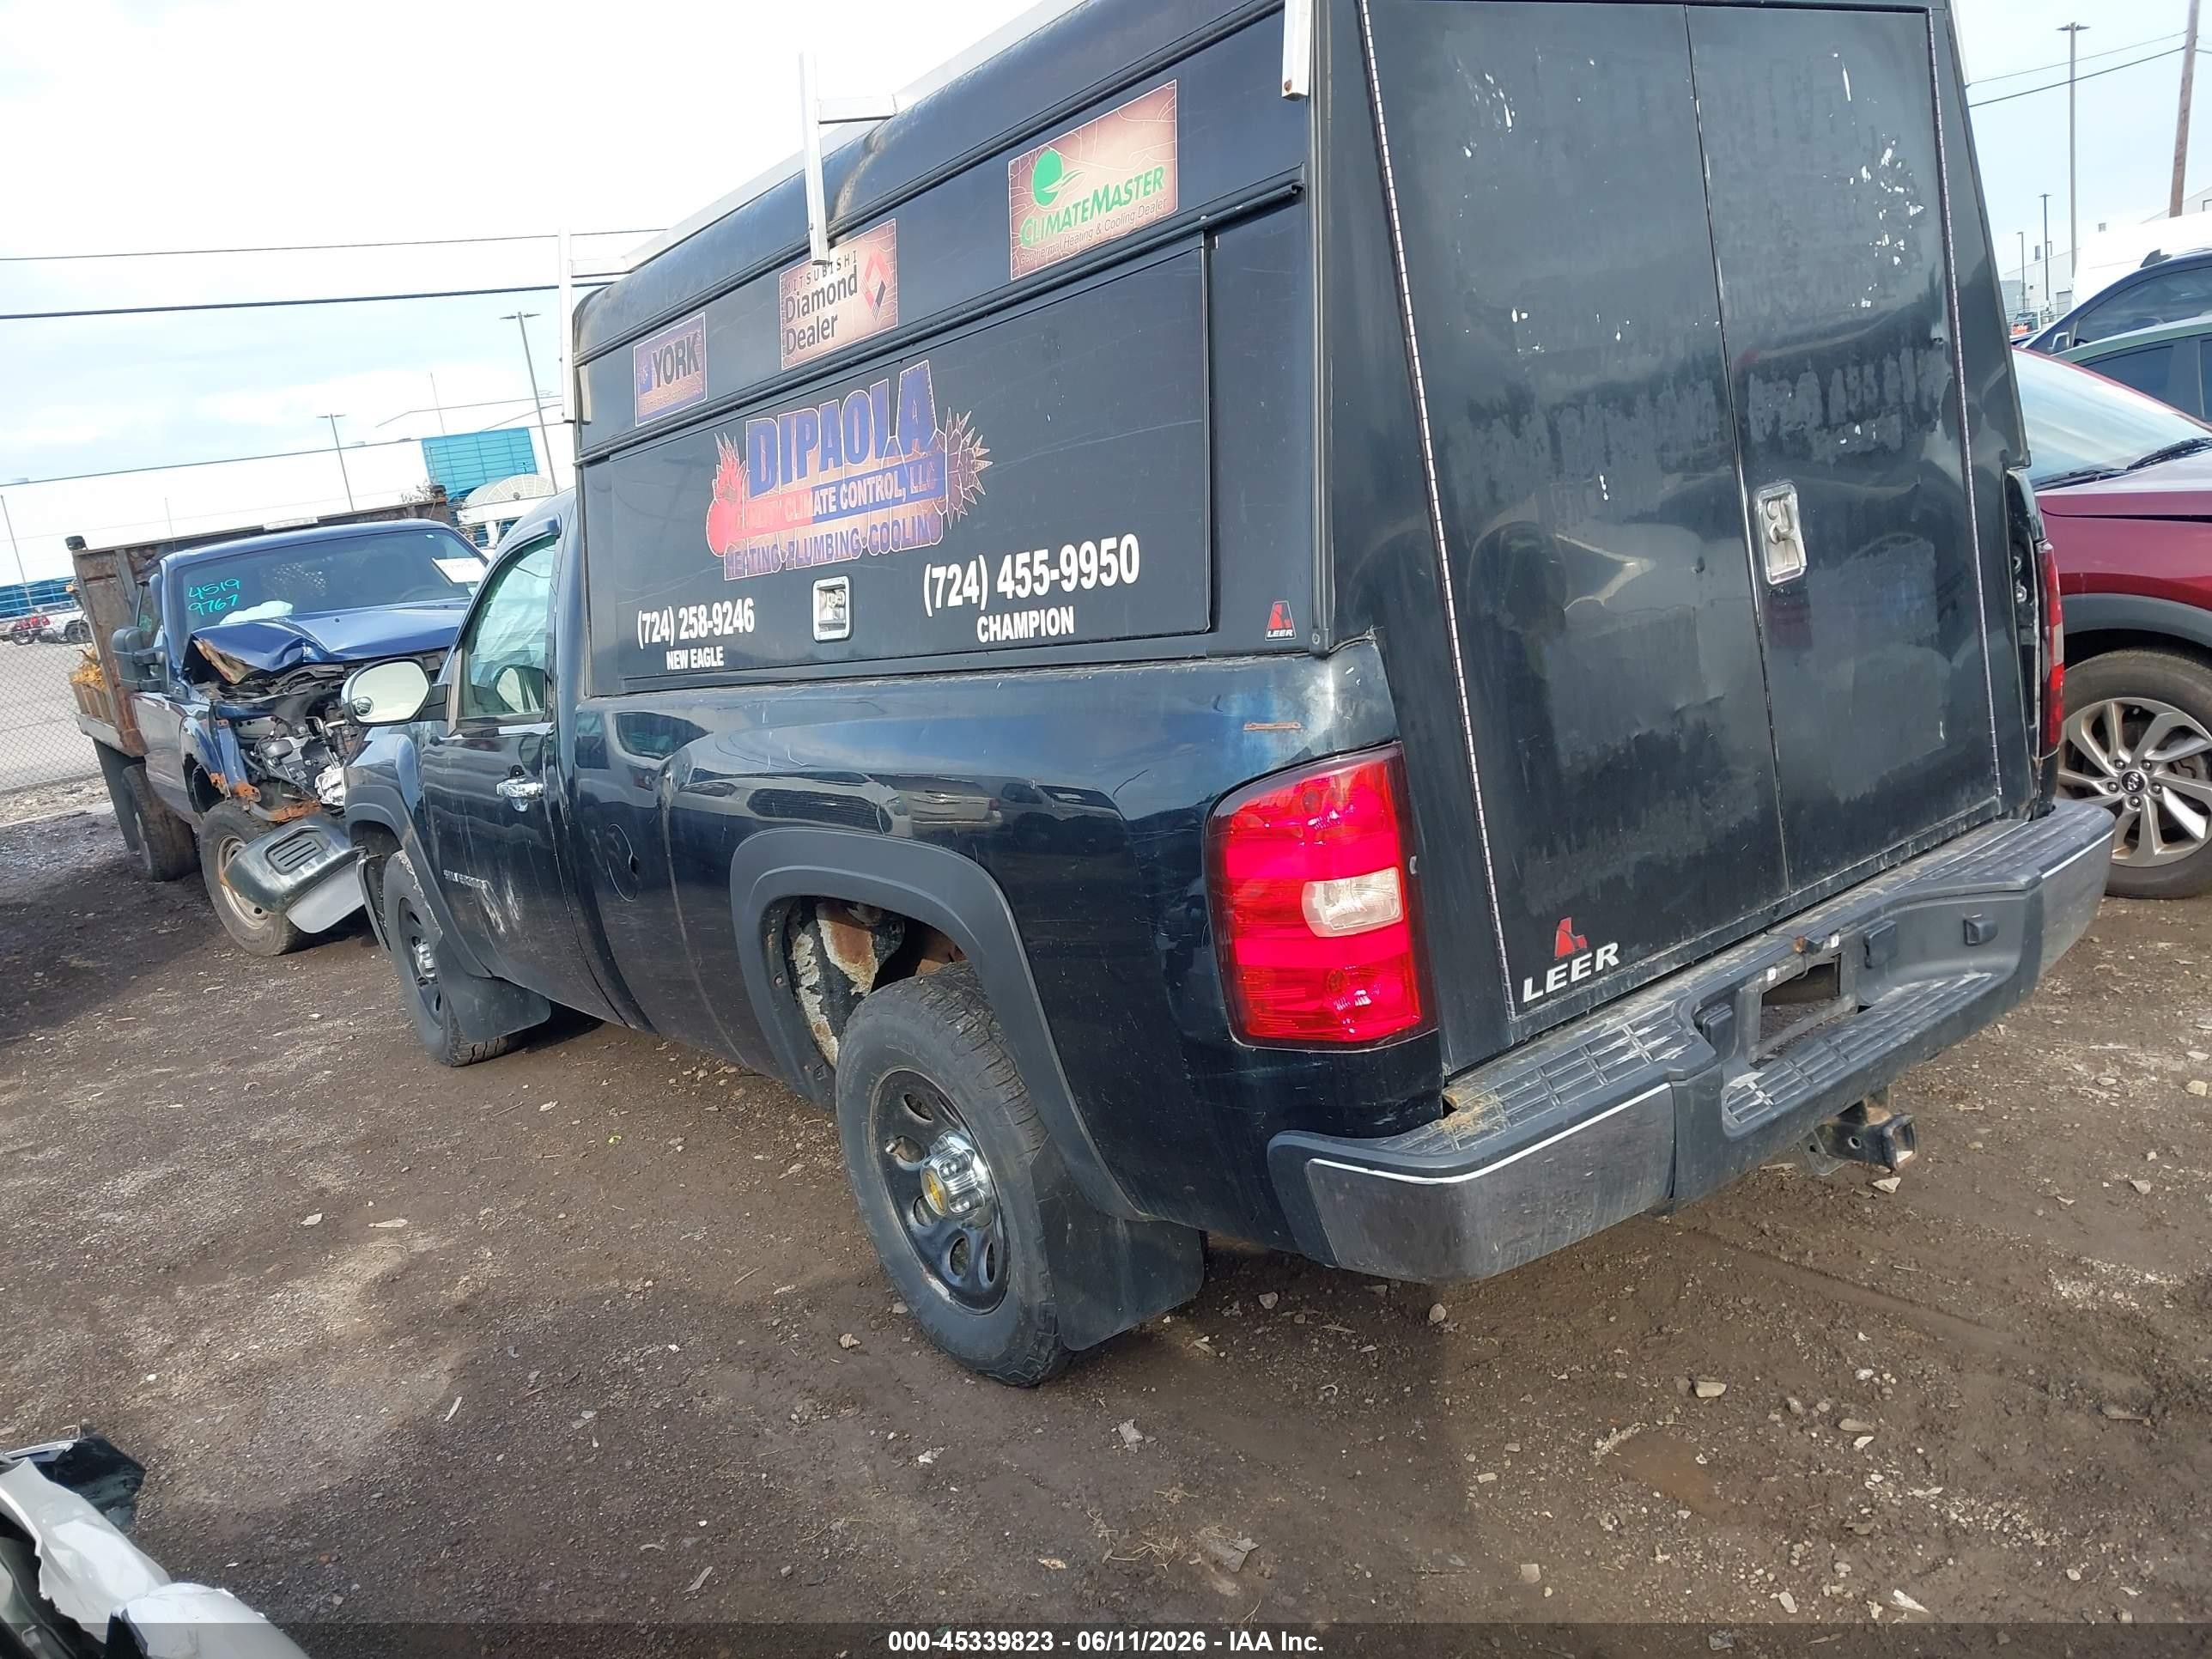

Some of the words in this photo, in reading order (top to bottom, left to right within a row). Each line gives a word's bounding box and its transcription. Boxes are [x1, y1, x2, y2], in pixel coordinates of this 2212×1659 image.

[1064, 228, 1093, 247] Heating
[1096, 225, 1103, 235] &
[1104, 212, 1136, 232] Cooling
[1138, 198, 1167, 218] Dealer
[785, 264, 858, 324] Diamond
[786, 314, 838, 356] Dealer
[653, 331, 700, 388] YORK
[746, 364, 936, 498] DIPAOLA
[840, 471, 906, 510] CONTROL,
[188, 578, 240, 599] 4519
[924, 555, 988, 617] (724)
[997, 533, 1139, 599] 455-9950
[187, 593, 239, 616] 9767
[637, 605, 675, 649] (724)
[679, 597, 755, 640] 258-9246
[976, 605, 1074, 642] CHAMPION
[1267, 629, 1293, 638] LEER
[665, 649, 689, 670] NEW
[690, 646, 724, 668] EAGLE
[1522, 942, 1620, 1003] LEER
